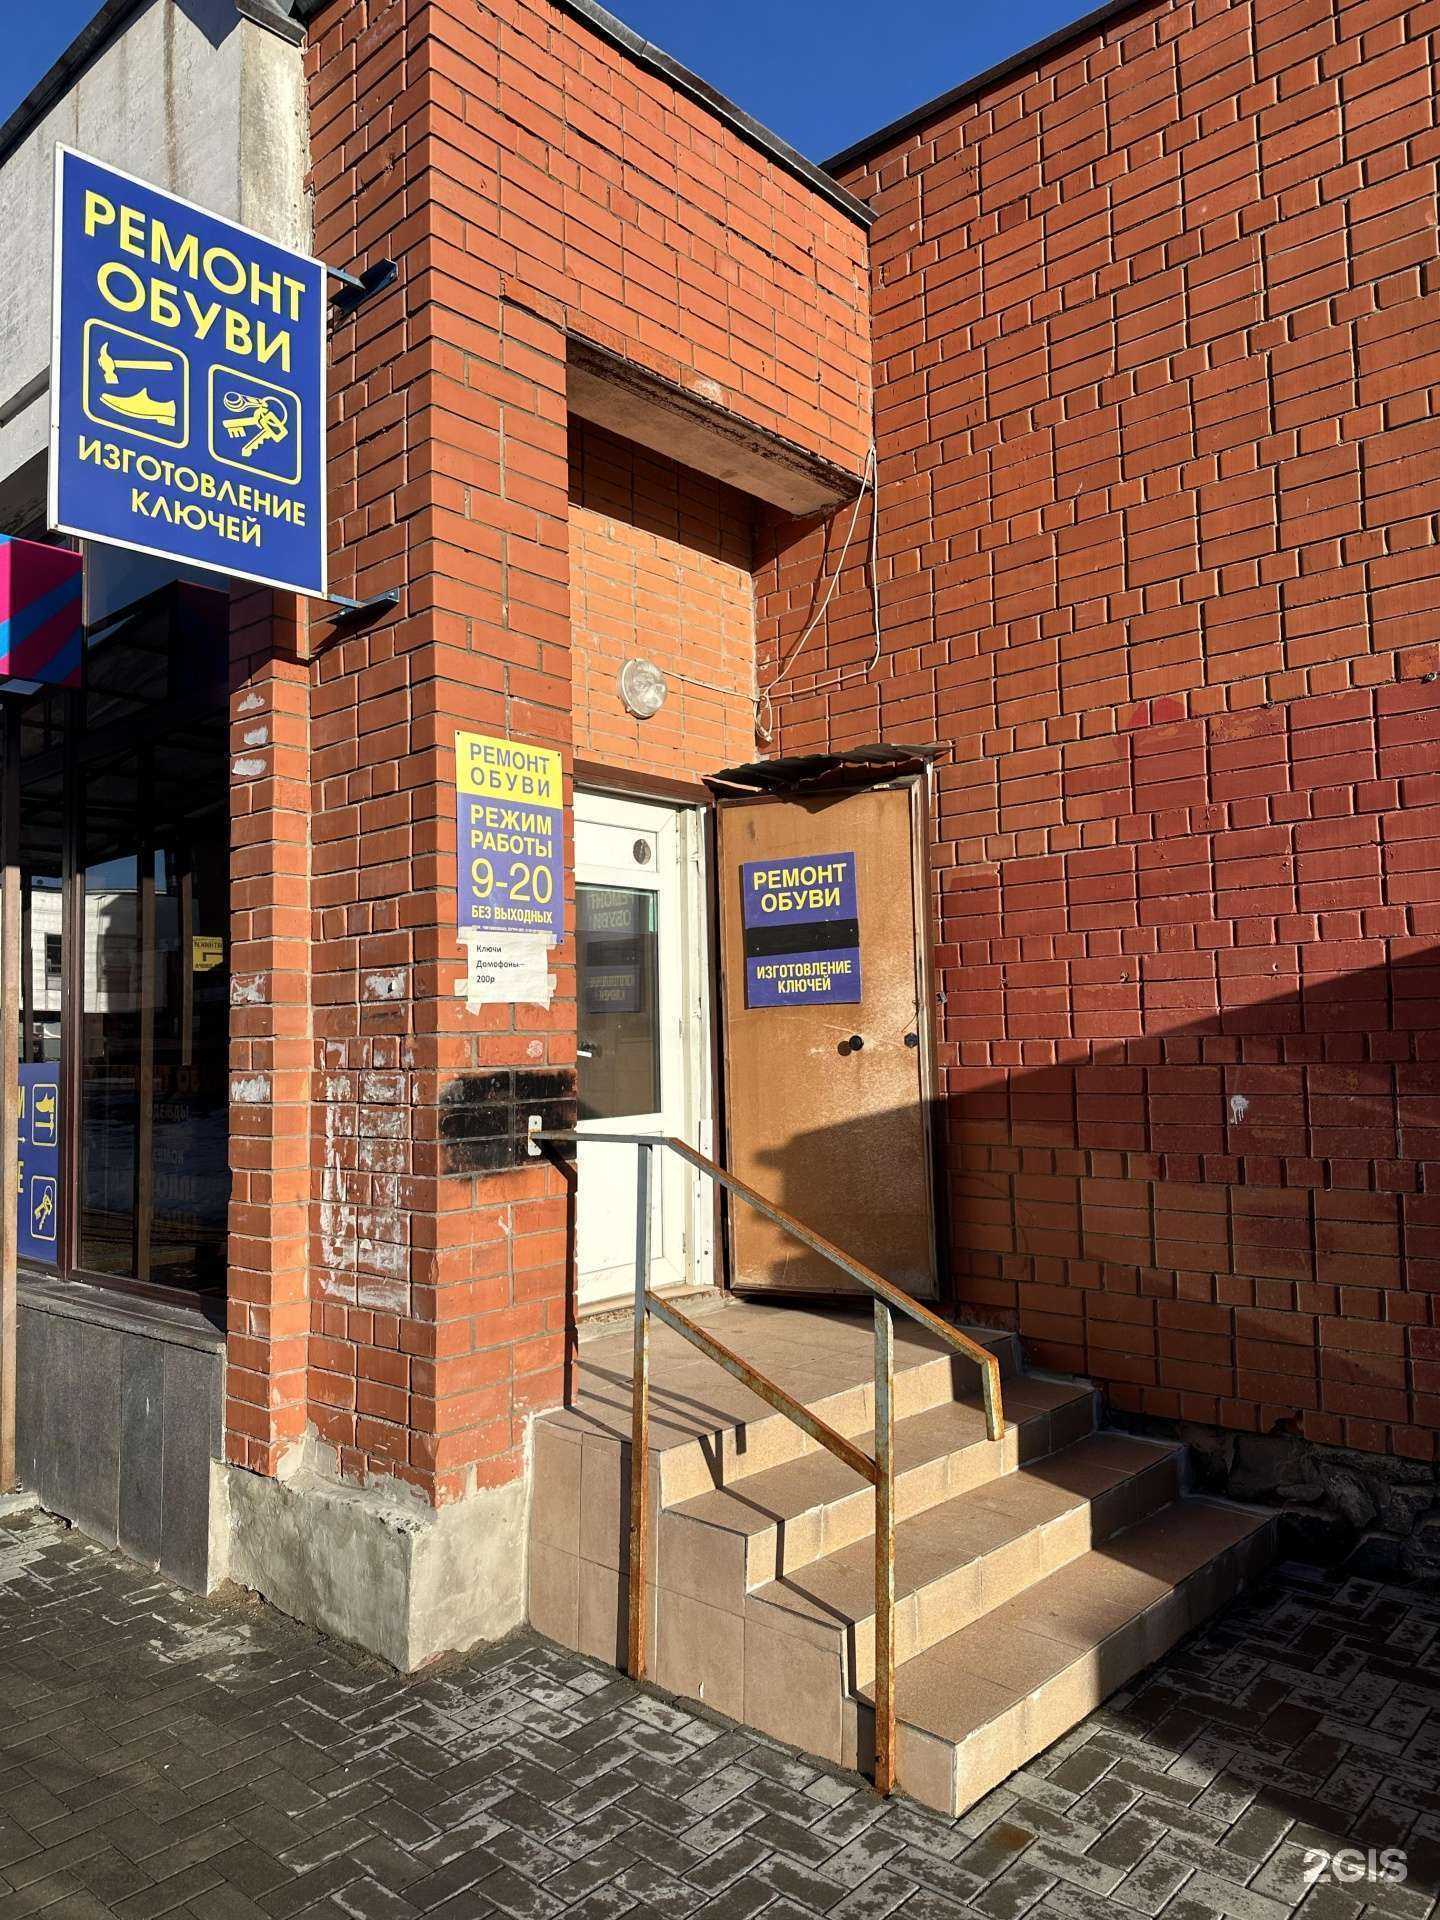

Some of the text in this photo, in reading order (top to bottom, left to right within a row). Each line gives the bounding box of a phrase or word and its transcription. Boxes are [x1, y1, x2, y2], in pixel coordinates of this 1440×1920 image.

[84, 189, 306, 321] РЕМОНТ
[97, 261, 292, 374] ОБУВИ
[79, 435, 306, 526] ИЗГОТОВЛЕНИЕ
[131, 487, 262, 548] КЛЮЧЕЙ
[470, 742, 550, 775] РЕМОНТ
[470, 767, 550, 798] ОБУВИ
[470, 804, 552, 836] РЕЖИМ
[470, 829, 553, 858] РАБОТЫ
[471, 857, 553, 904] 9-20
[753, 863, 847, 890] РЕМОНТ
[471, 904, 553, 924] БЕЗ ВЫХОДНЫХ
[761, 887, 841, 913] ОБУВИ
[476, 945, 502, 953] Ключи
[476, 975, 495, 984] 200р
[757, 960, 852, 980] ИЗГОТОВЛЕНИЕ
[778, 974, 831, 994] КЛЮЧЕЙ
